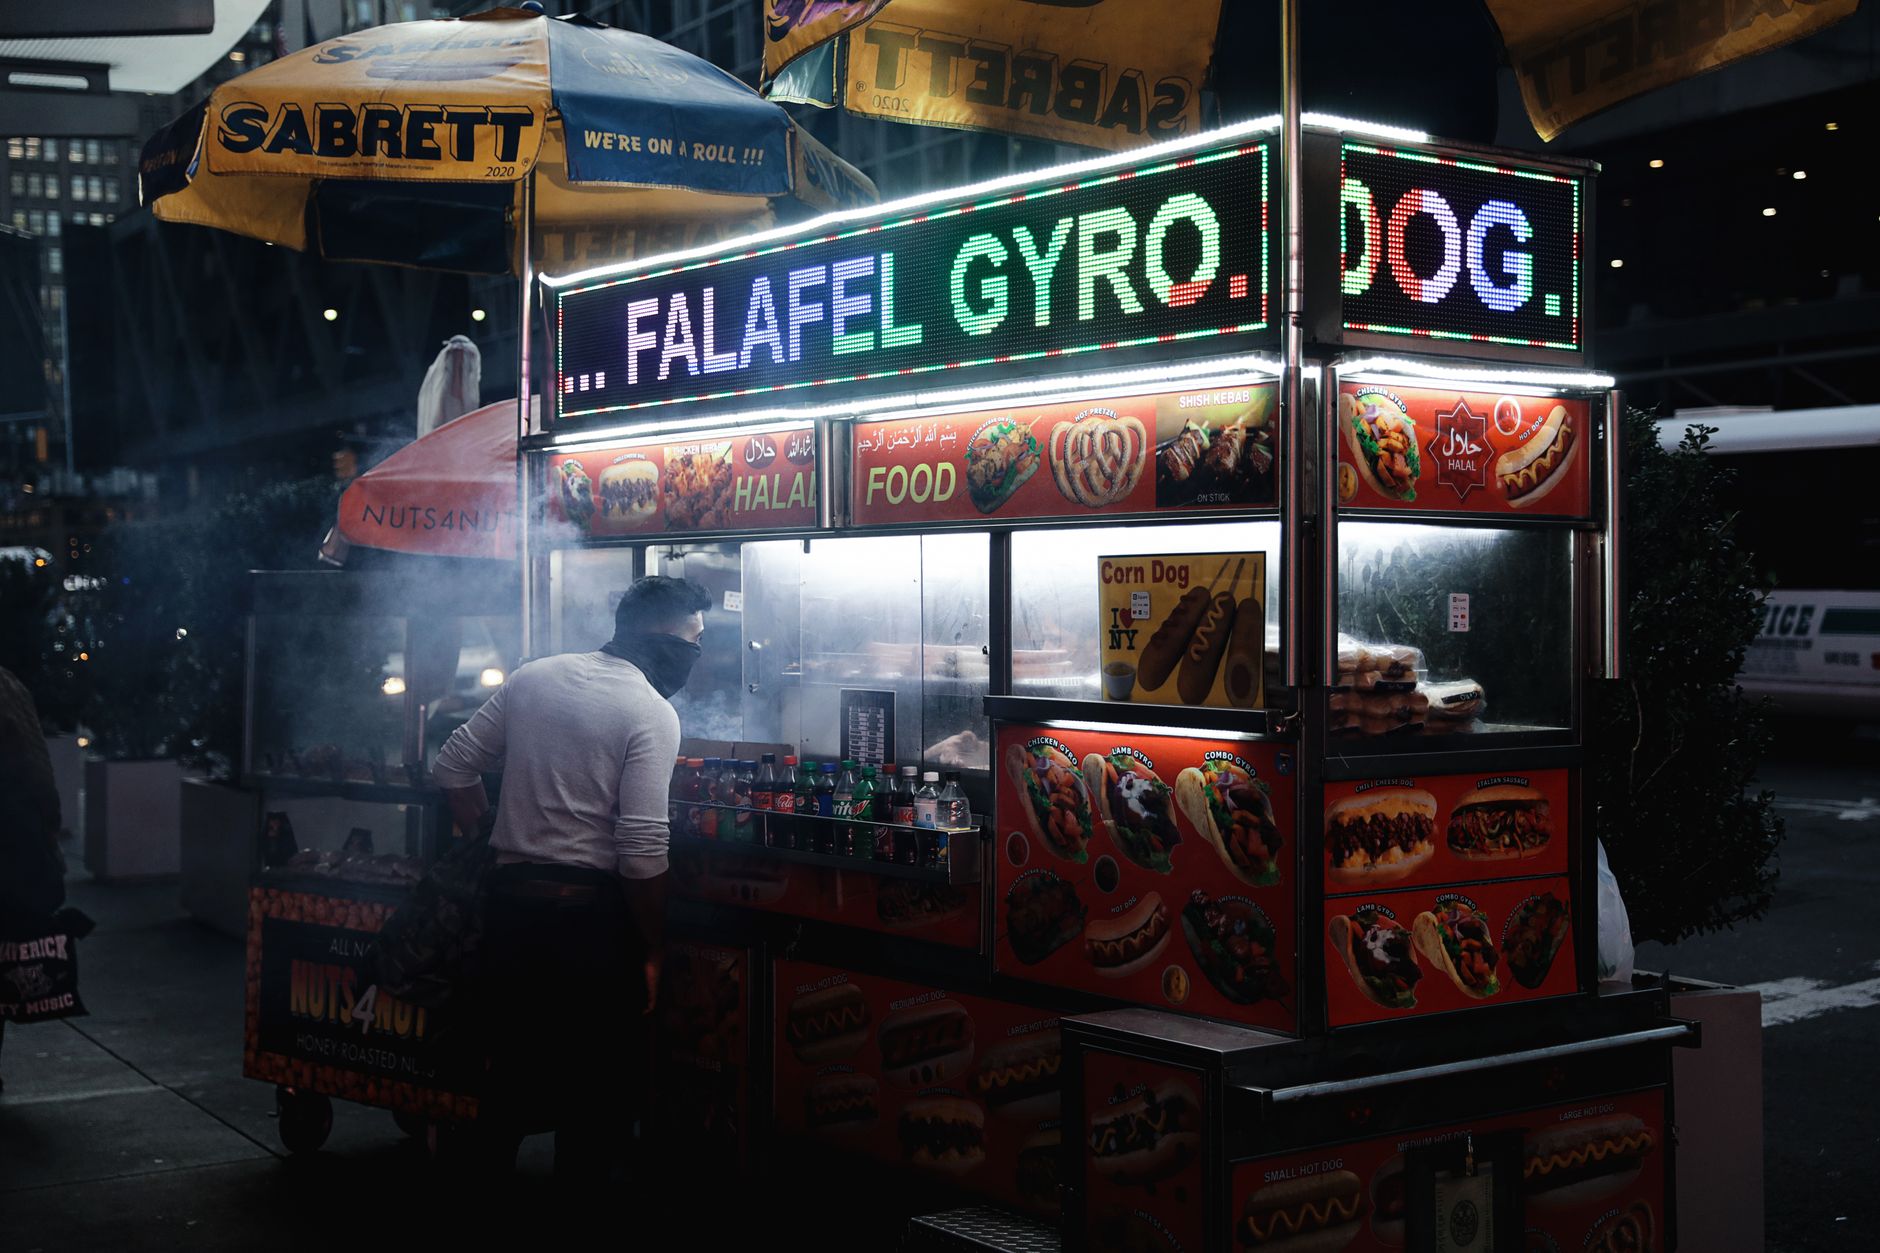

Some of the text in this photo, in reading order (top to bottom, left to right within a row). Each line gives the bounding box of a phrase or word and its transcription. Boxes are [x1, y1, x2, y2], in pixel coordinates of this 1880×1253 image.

[217, 101, 535, 162] SABRETT
[584, 130, 641, 152] WE'RE
[647, 137, 673, 155] ON
[679, 140, 687, 158] A
[692, 142, 736, 164] ROLL
[485, 166, 515, 177] 2020
[628, 253, 922, 384] FALAFEL
[951, 193, 1248, 335] GYRO.
[1179, 390, 1250, 409] SHISH KEBAB
[1356, 388, 1408, 414] CHICKEN GYRO
[1075, 408, 1118, 422] HOT PRETZEL
[1518, 415, 1544, 441] HOT DOG
[1448, 460, 1477, 472] HALAL
[866, 461, 957, 506] FOOD
[1101, 559, 1189, 589] Corn Dog
[1109, 629, 1138, 650] NY
[1028, 736, 1078, 765] CHICKEN GYRO
[1111, 746, 1153, 769] LAMB GYRO
[1205, 752, 1256, 776] COMBO GYRO
[1111, 896, 1137, 914] HOT DOG
[1357, 904, 1395, 919] LAMB GYRO
[1436, 894, 1476, 911] COMBO GYRO
[329, 938, 350, 956] ALL
[796, 973, 848, 995] SMALL HOT DOG
[25, 992, 75, 1015] MUSIC
[890, 989, 946, 1010] MEDIUM HOT DOG
[1559, 1103, 1614, 1121] LARGE HOT DOG
[1264, 1158, 1344, 1183] SMALL HOT DOG
